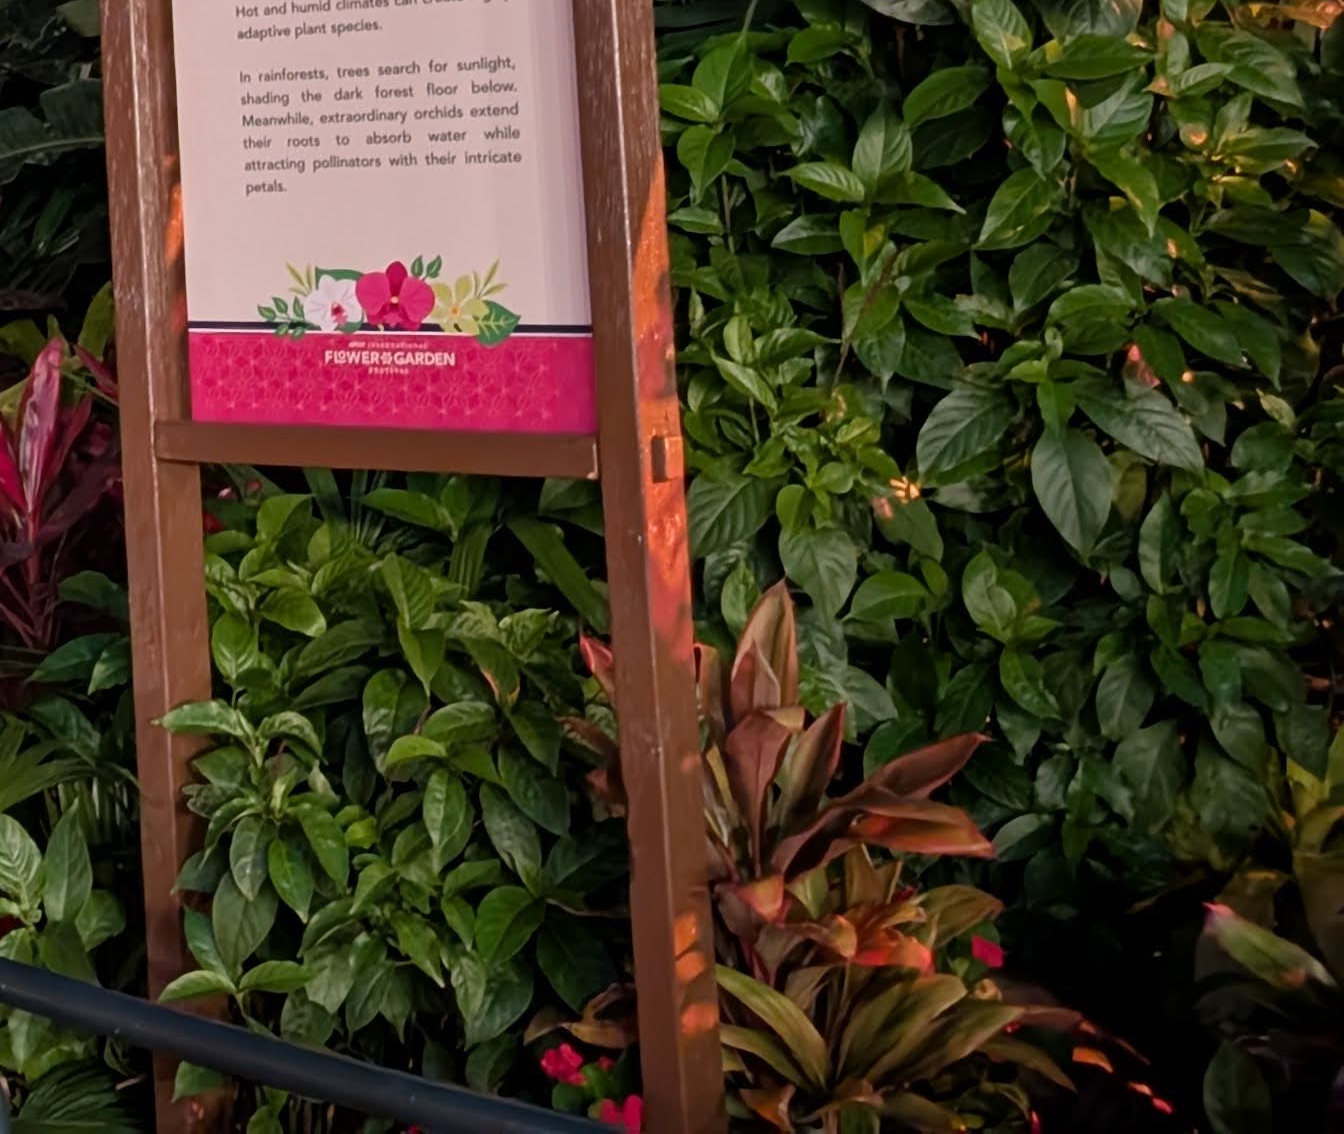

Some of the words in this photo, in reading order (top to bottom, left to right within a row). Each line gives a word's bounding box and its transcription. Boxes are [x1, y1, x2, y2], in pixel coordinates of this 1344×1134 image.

[234, 4, 260, 19] Hot
[262, 1, 288, 17] and
[236, 21, 292, 43] adaptive
[293, 20, 328, 40] plant
[330, 17, 384, 38] species.
[239, 71, 252, 83] In
[258, 66, 330, 83] rainforests,
[336, 65, 371, 80] trees
[377, 60, 421, 76] search
[428, 58, 449, 73] for
[455, 55, 517, 74] sunlight,
[240, 91, 291, 108] shading
[300, 89, 323, 103] the
[333, 86, 364, 102] dark
[374, 84, 415, 99] forest
[426, 81, 459, 97] floor
[470, 78, 518, 95] below.
[241, 111, 315, 128] Meanwhile,
[319, 108, 409, 126] extraordinary
[413, 104, 464, 121] orchids
[469, 101, 520, 118] extend
[242, 135, 273, 150] their
[286, 134, 321, 148] roots
[335, 133, 351, 147] to
[365, 129, 413, 146] absorb
[427, 129, 468, 143] water
[483, 124, 522, 141] while
[243, 157, 306, 175] attracting
[311, 155, 383, 174] pollinators
[388, 152, 418, 168] with
[424, 151, 458, 166] their
[464, 150, 524, 165] intricate
[245, 178, 289, 197] petals.
[394, 351, 456, 366] GARDEN
